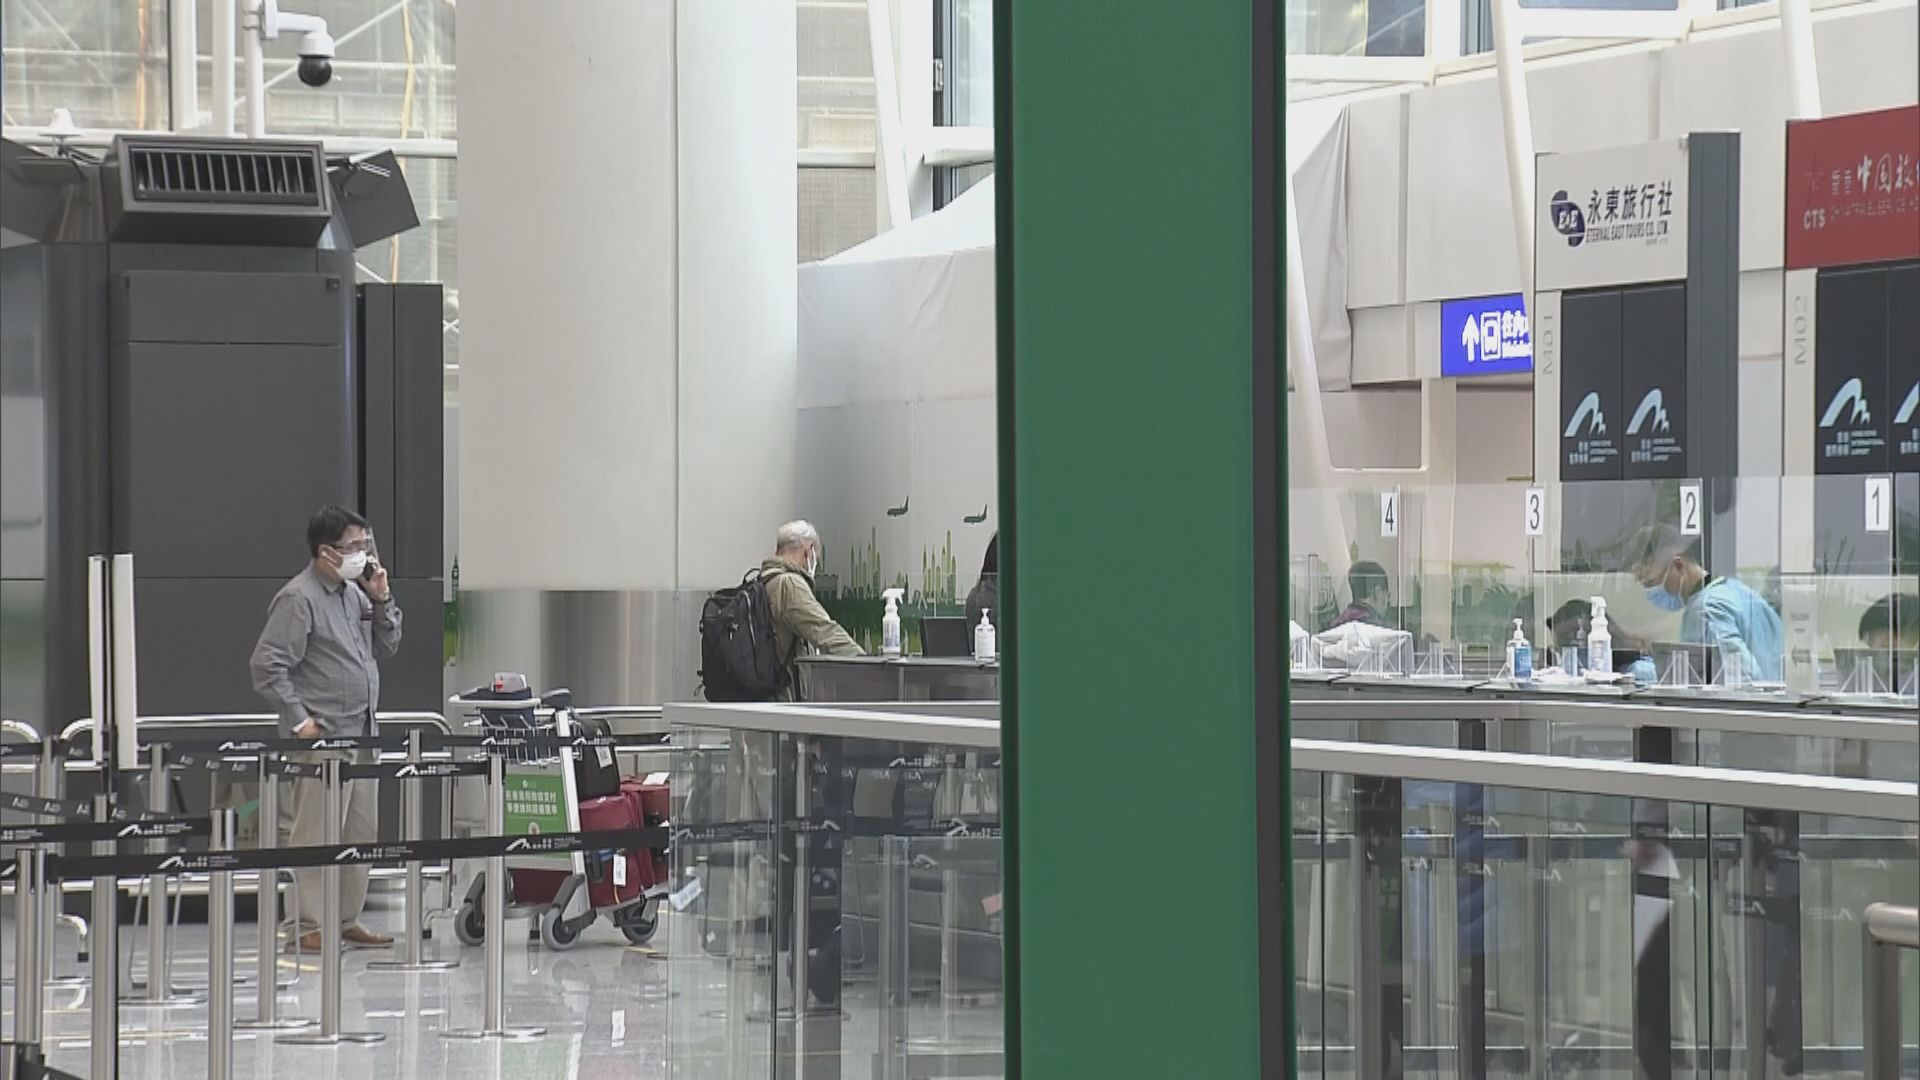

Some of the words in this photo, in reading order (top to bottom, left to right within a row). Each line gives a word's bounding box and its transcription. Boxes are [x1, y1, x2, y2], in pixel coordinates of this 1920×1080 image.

[1587, 180, 1672, 224] 永東旅行社
[1804, 207, 1825, 231] CTS
[1384, 495, 1395, 532] 4
[1529, 493, 1540, 531] 3
[1685, 491, 1697, 530] 2
[1871, 484, 1881, 526] 1
